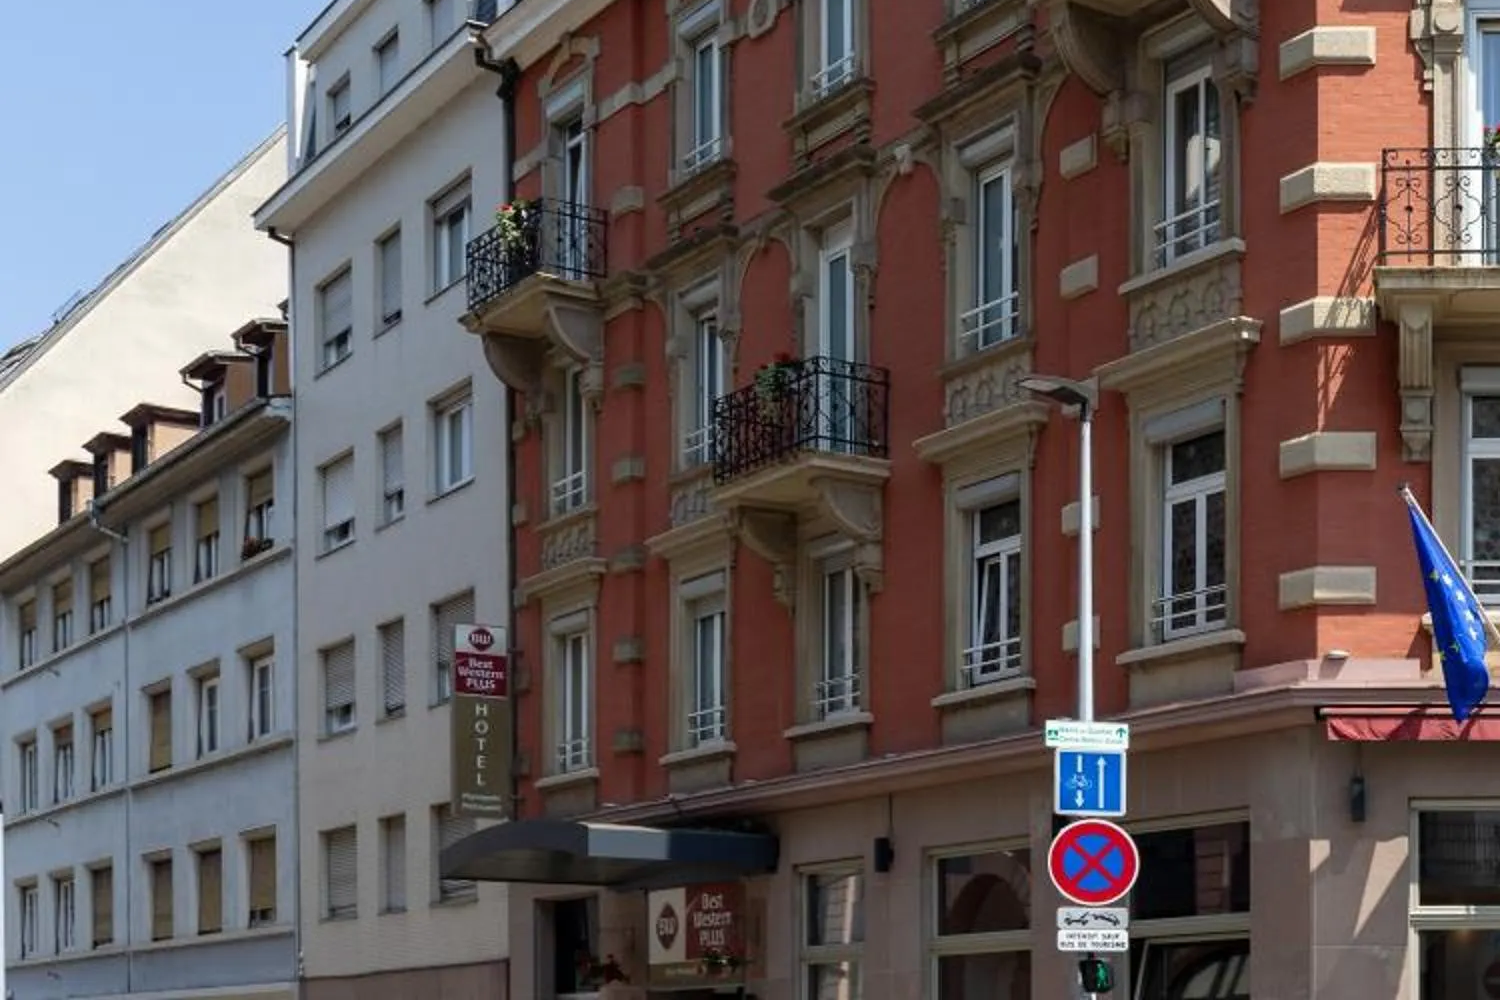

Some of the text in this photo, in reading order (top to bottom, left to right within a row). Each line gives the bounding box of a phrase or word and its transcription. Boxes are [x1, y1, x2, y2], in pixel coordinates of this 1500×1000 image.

[468, 657, 493, 669] Best
[458, 666, 504, 679] Western
[474, 703, 489, 787] HOTEL
